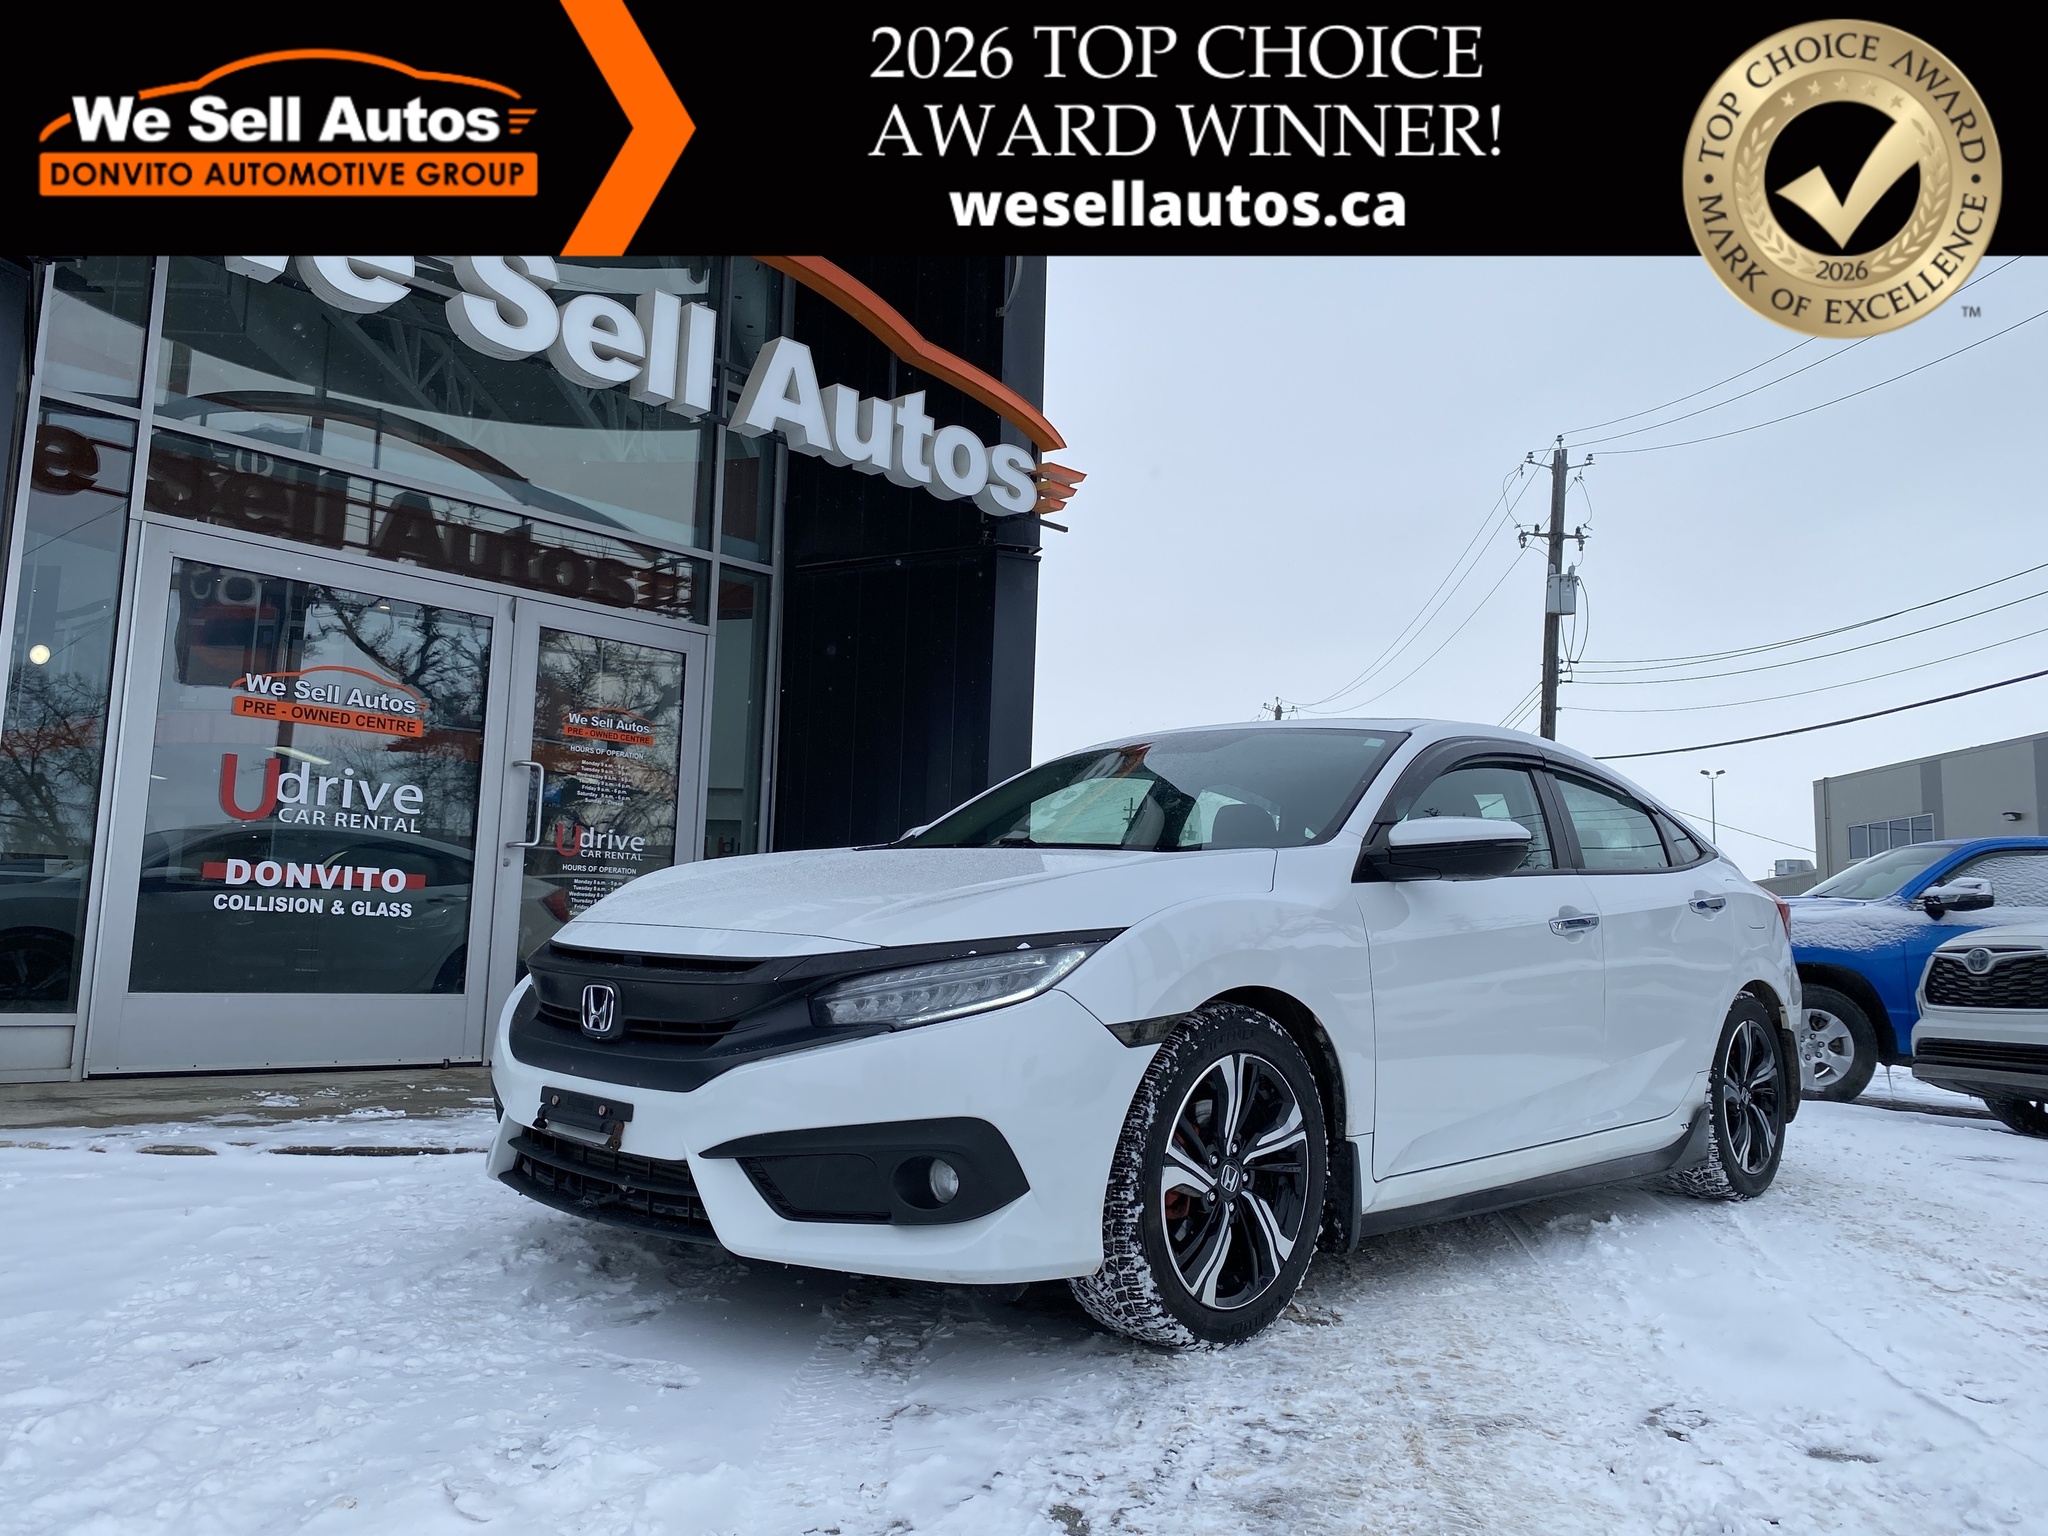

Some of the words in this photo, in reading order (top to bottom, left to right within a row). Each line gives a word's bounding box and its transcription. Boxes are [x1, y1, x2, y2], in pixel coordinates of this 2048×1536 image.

[445, 256, 717, 418] Sell
[727, 335, 1038, 517] Autos
[245, 672, 287, 697] We
[293, 679, 340, 704] Sell
[347, 688, 418, 715] Autos
[242, 700, 277, 717] PRE
[291, 706, 351, 726] OWNED
[355, 715, 417, 734] CENTRE
[568, 712, 588, 725] We
[591, 716, 613, 729] Sell
[616, 720, 650, 734] Autos
[567, 727, 583, 735] PRE
[590, 730, 619, 740] OWNED
[620, 734, 650, 744] CENTRE
[570, 745, 594, 754] HOURS
[607, 749, 644, 760] OPERATION
[218, 752, 424, 822] Udrive
[582, 784, 596, 792] Friday
[278, 807, 326, 827] CAR
[334, 812, 421, 834] RENTAL
[556, 822, 645, 857] Udrive
[580, 849, 602, 858] CAR
[604, 851, 643, 861] RENTAL
[225, 858, 407, 893] DONVITO
[562, 864, 587, 872] HOURS
[599, 866, 637, 874] OPERATION
[213, 894, 324, 915] COLLISION
[331, 900, 345, 915] &
[351, 901, 413, 918] GLASS
[569, 891, 596, 899] Wednesday
